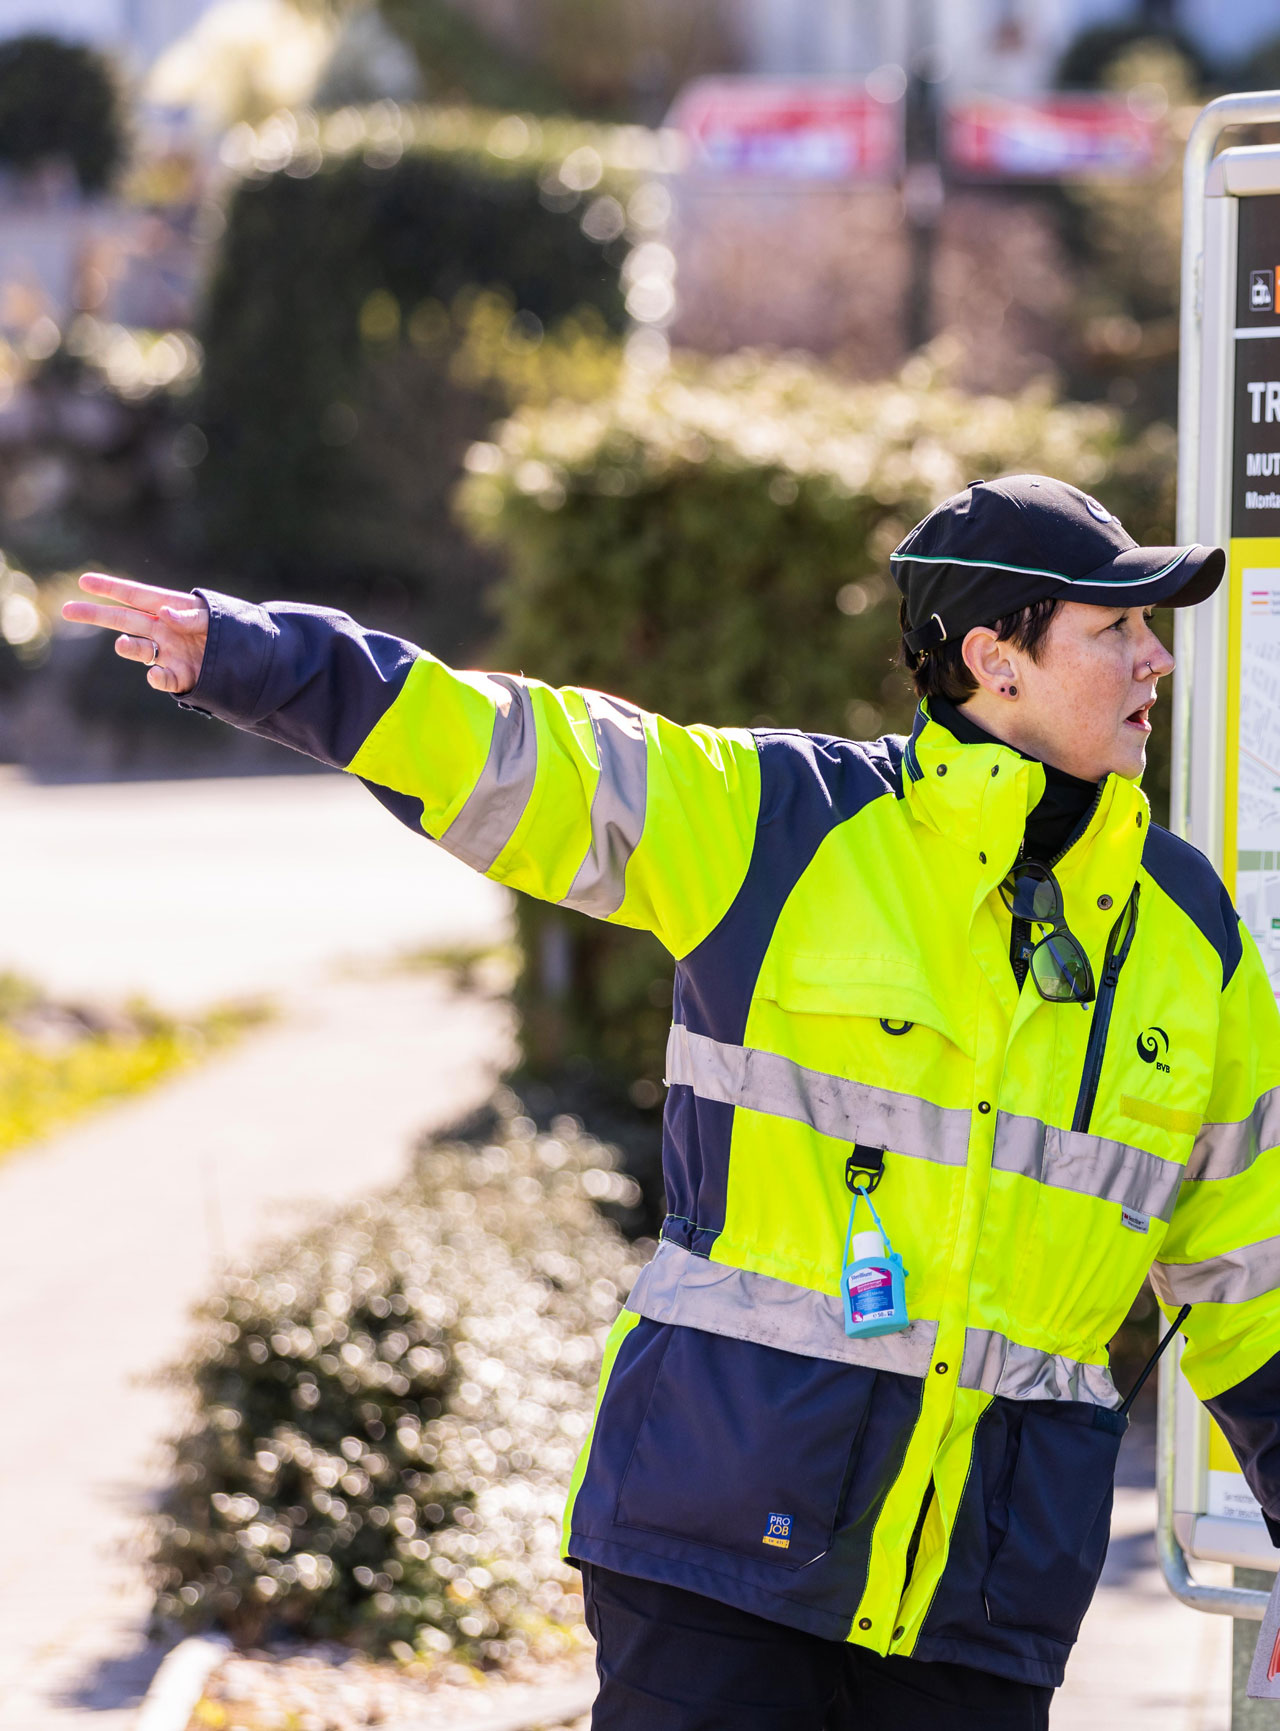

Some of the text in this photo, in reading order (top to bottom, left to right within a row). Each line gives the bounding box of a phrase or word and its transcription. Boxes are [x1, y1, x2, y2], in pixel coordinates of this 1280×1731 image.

[1156, 1062, 1170, 1074] BVB
[770, 1515, 790, 1525] PRO
[768, 1524, 789, 1536] JOB
